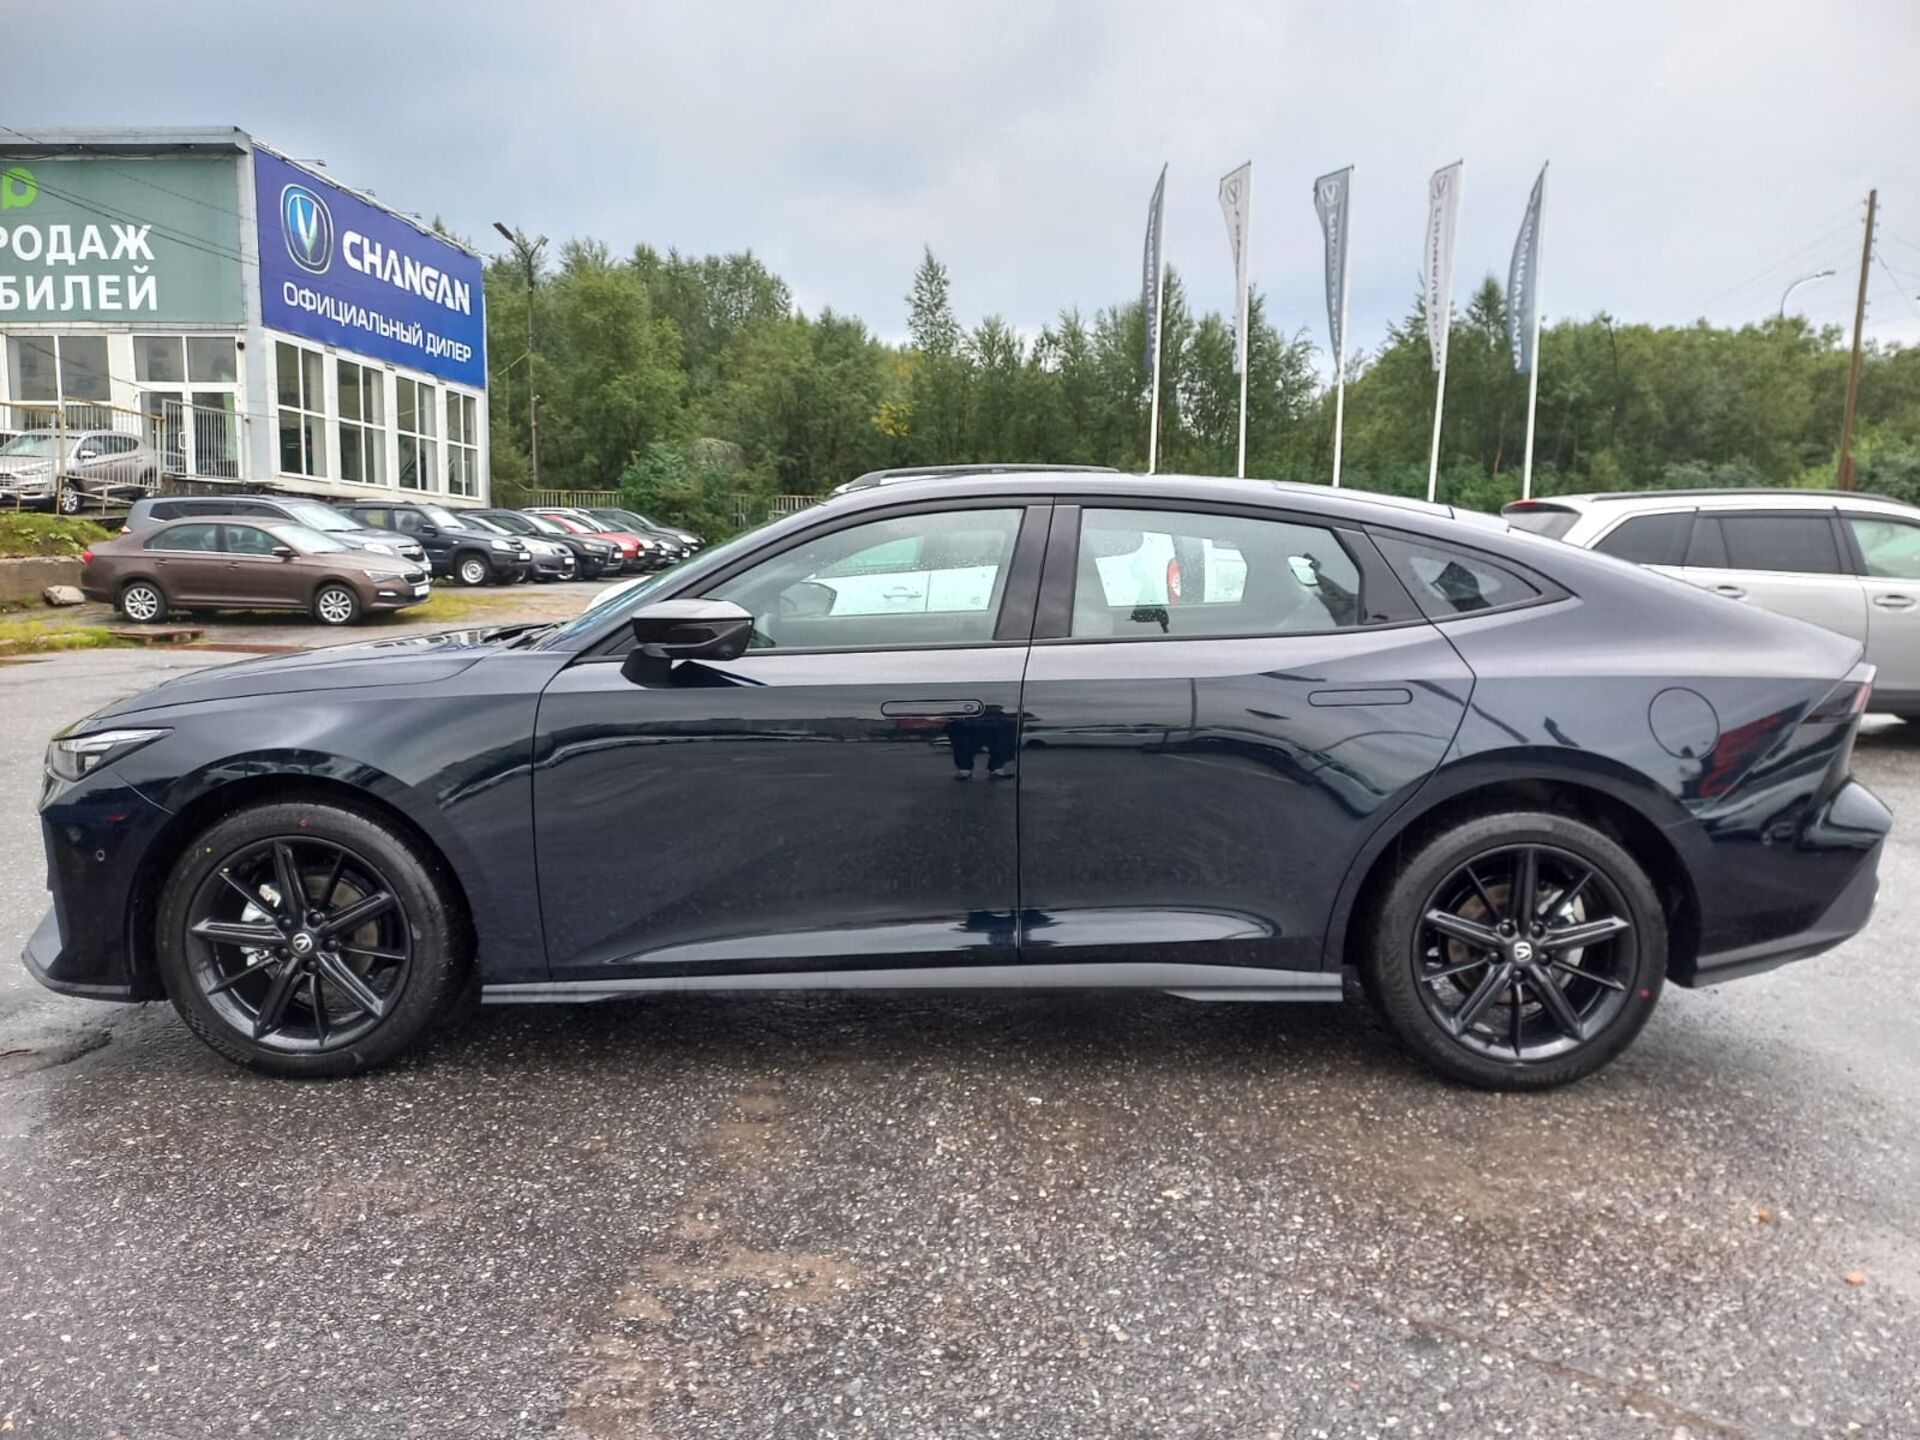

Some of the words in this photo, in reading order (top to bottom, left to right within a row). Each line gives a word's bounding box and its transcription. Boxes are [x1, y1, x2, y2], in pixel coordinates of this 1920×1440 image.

[0, 264, 158, 311] БИЛЕЙ
[342, 230, 471, 316] CHANGAN
[283, 281, 423, 348] ОФИЦИАЛЬНЫЙ
[425, 332, 471, 363] ДИЛЕР
